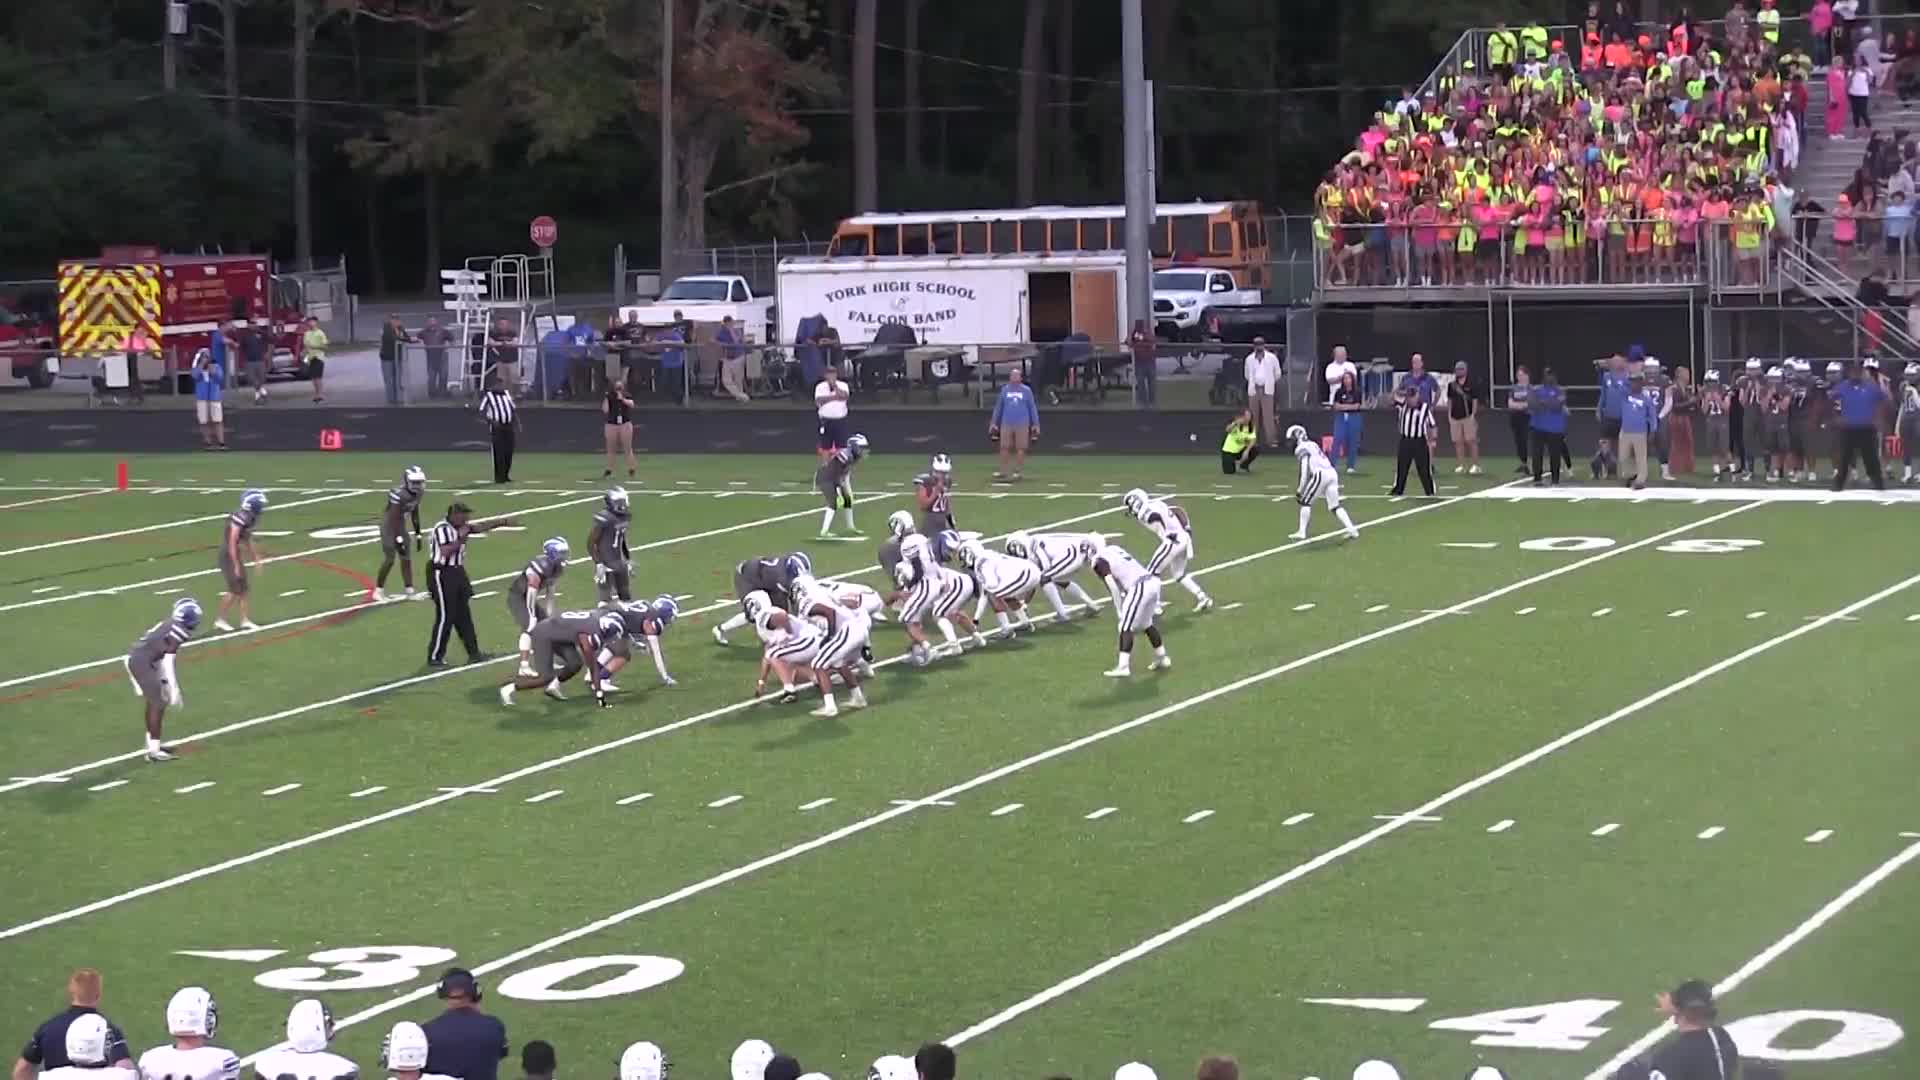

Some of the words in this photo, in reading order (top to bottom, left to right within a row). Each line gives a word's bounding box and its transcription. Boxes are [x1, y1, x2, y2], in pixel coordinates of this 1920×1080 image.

[825, 286, 867, 303] YORK
[873, 281, 911, 294] HIGH
[916, 281, 977, 300] SCHOOL
[848, 310, 907, 326] FALCON
[914, 308, 957, 325] BAND
[253, 944, 685, 1000] 30
[1427, 998, 1905, 1060] 40
